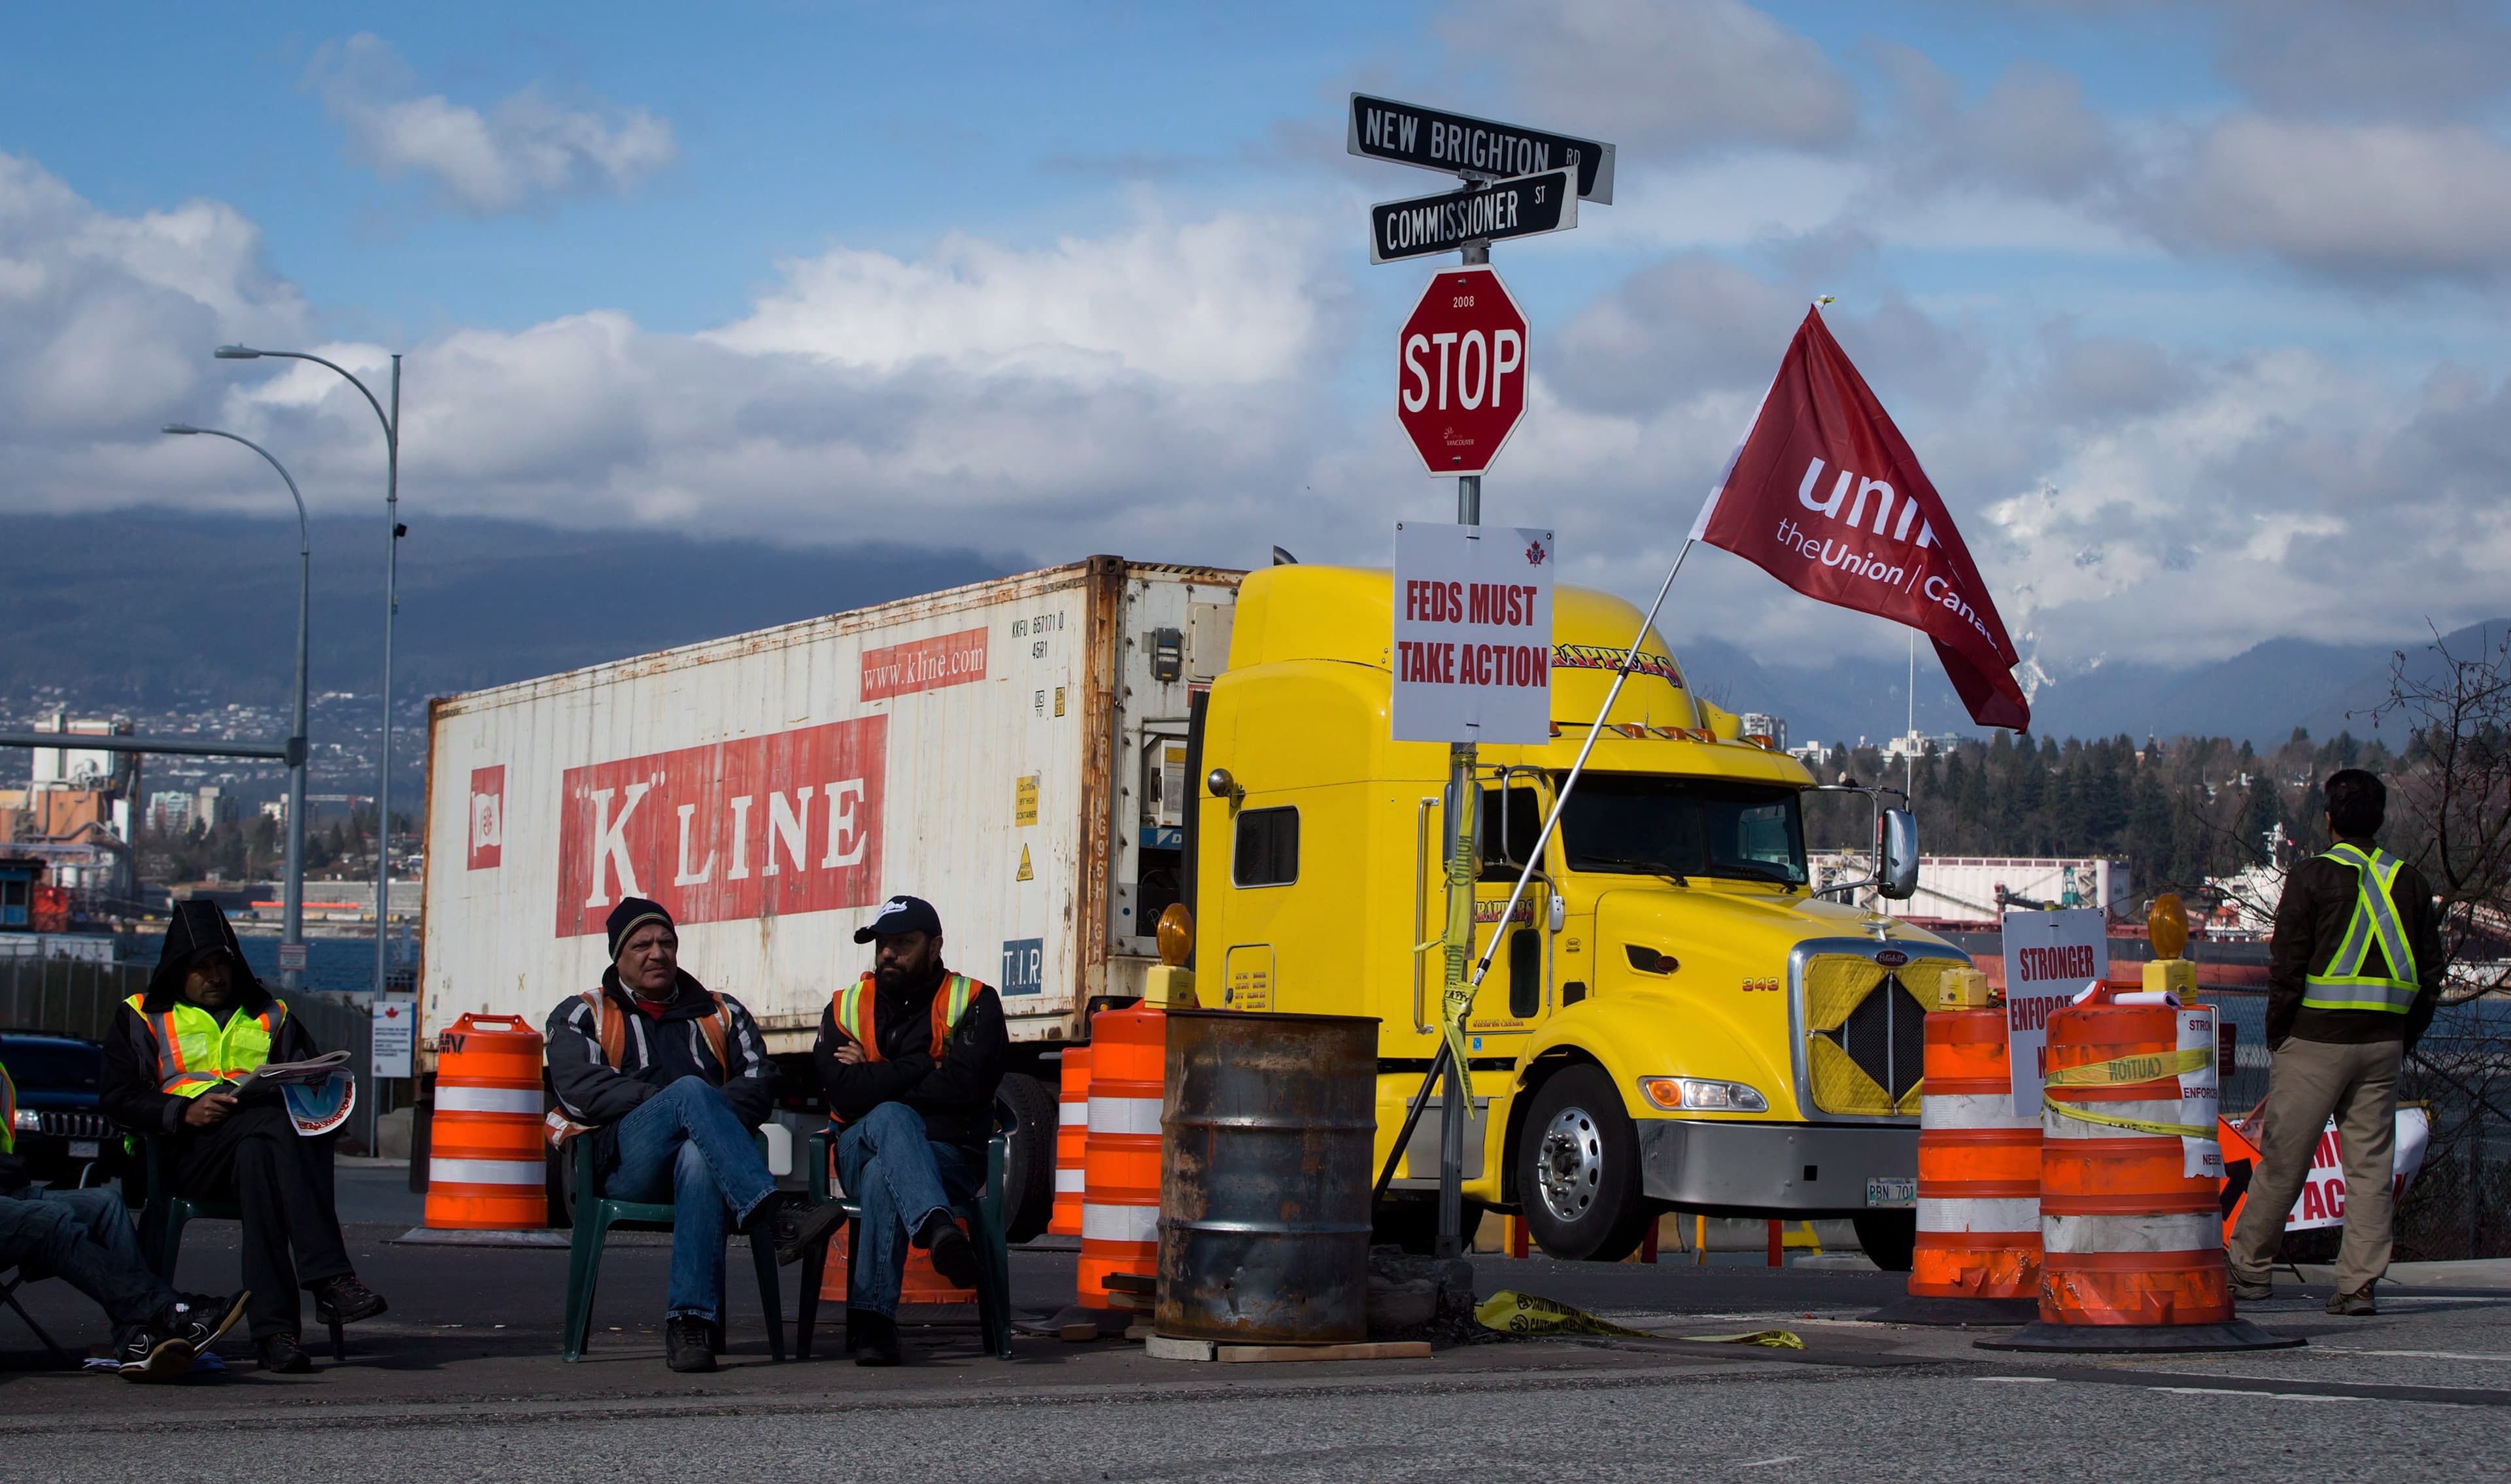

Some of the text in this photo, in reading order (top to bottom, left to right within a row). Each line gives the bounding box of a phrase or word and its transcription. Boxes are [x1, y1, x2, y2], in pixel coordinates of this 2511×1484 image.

[1365, 108, 1581, 173] NEW BRIGHTON RD
[1386, 185, 1546, 250] COMMISSIONER ST
[1453, 295, 1475, 309] 2008
[1403, 329, 1522, 413] STOP
[1775, 517, 1904, 586] theUnion
[1407, 580, 1537, 626] FEDS MUST
[1012, 619, 1028, 639] KKFU
[1033, 614, 1055, 634] 657171
[863, 645, 984, 690] www.kline.com
[1032, 640, 1048, 660] 45R1
[1398, 641, 1547, 687] TAKE ACTION
[1098, 696, 1110, 836] WARNING
[674, 777, 868, 887] LINE
[1093, 881, 1104, 962] HIGH
[1004, 949, 1041, 986] T.I.R.
[1742, 977, 1779, 992] 343
[2019, 945, 2094, 982] STRONGER
[1870, 1185, 1913, 1200] PBN 701
